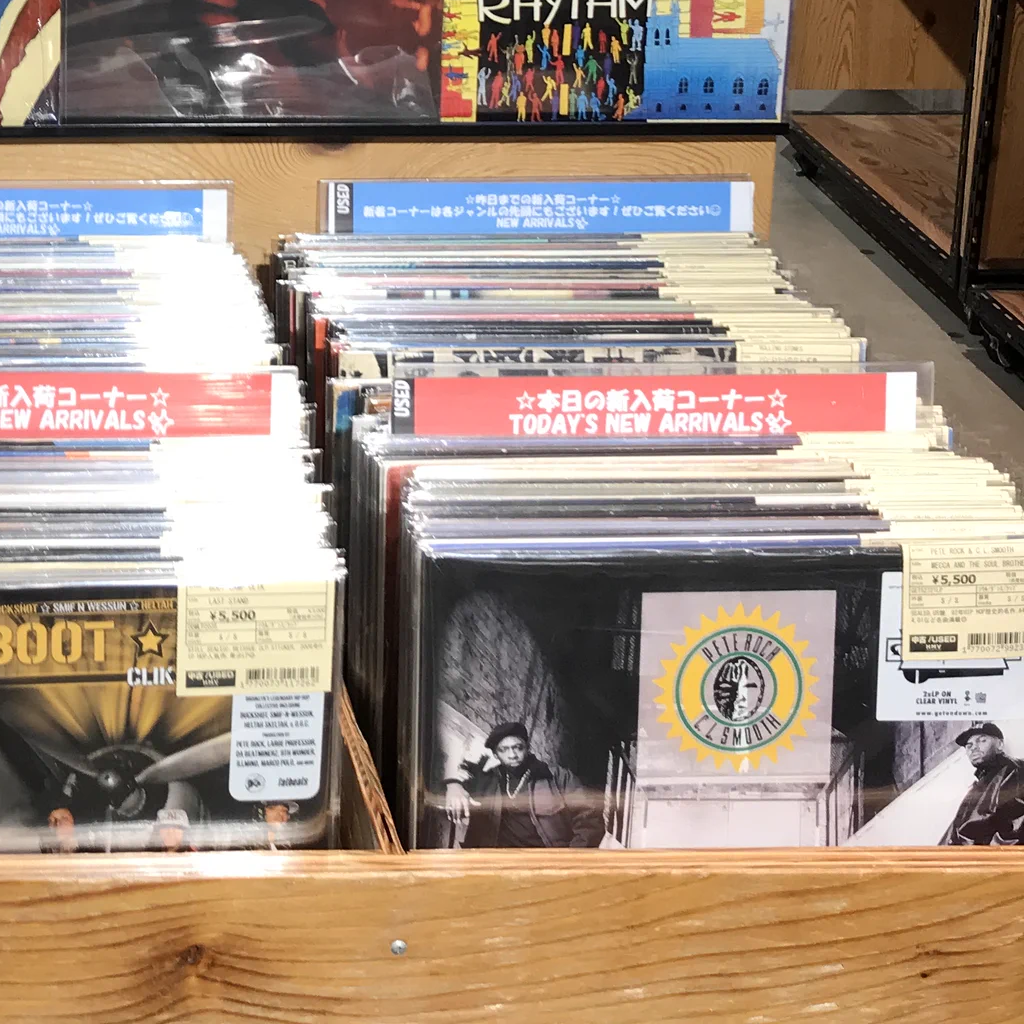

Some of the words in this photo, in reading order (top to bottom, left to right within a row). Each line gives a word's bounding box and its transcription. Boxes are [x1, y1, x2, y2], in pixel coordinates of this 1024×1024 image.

[336, 183, 351, 215] USED
[496, 218, 519, 228] NEW
[522, 217, 574, 228] ARRIVALS
[393, 379, 411, 418] USED
[537, 388, 766, 412] 本日の新入荷コーナー
[39, 408, 147, 430] ARRIVALS
[509, 413, 598, 435] TODAY'S
[605, 412, 652, 434] NEW
[658, 411, 764, 433] ARRIVALS
[931, 547, 946, 555] PETE
[949, 546, 965, 554] ROCK
[931, 560, 951, 569] MECCA
[954, 560, 966, 568] AND
[969, 560, 980, 568] THE
[984, 560, 998, 568] SOUL
[932, 574, 976, 586] ¥5,500
[210, 610, 256, 622] ¥5,500
[702, 633, 739, 663] PETE
[744, 633, 781, 663] ROCK
[127, 666, 175, 687] CLIK
[721, 713, 781, 746] SMOOTH
[236, 740, 250, 748] PETE
[267, 739, 284, 747] LARGE
[261, 759, 280, 767] MARCO
